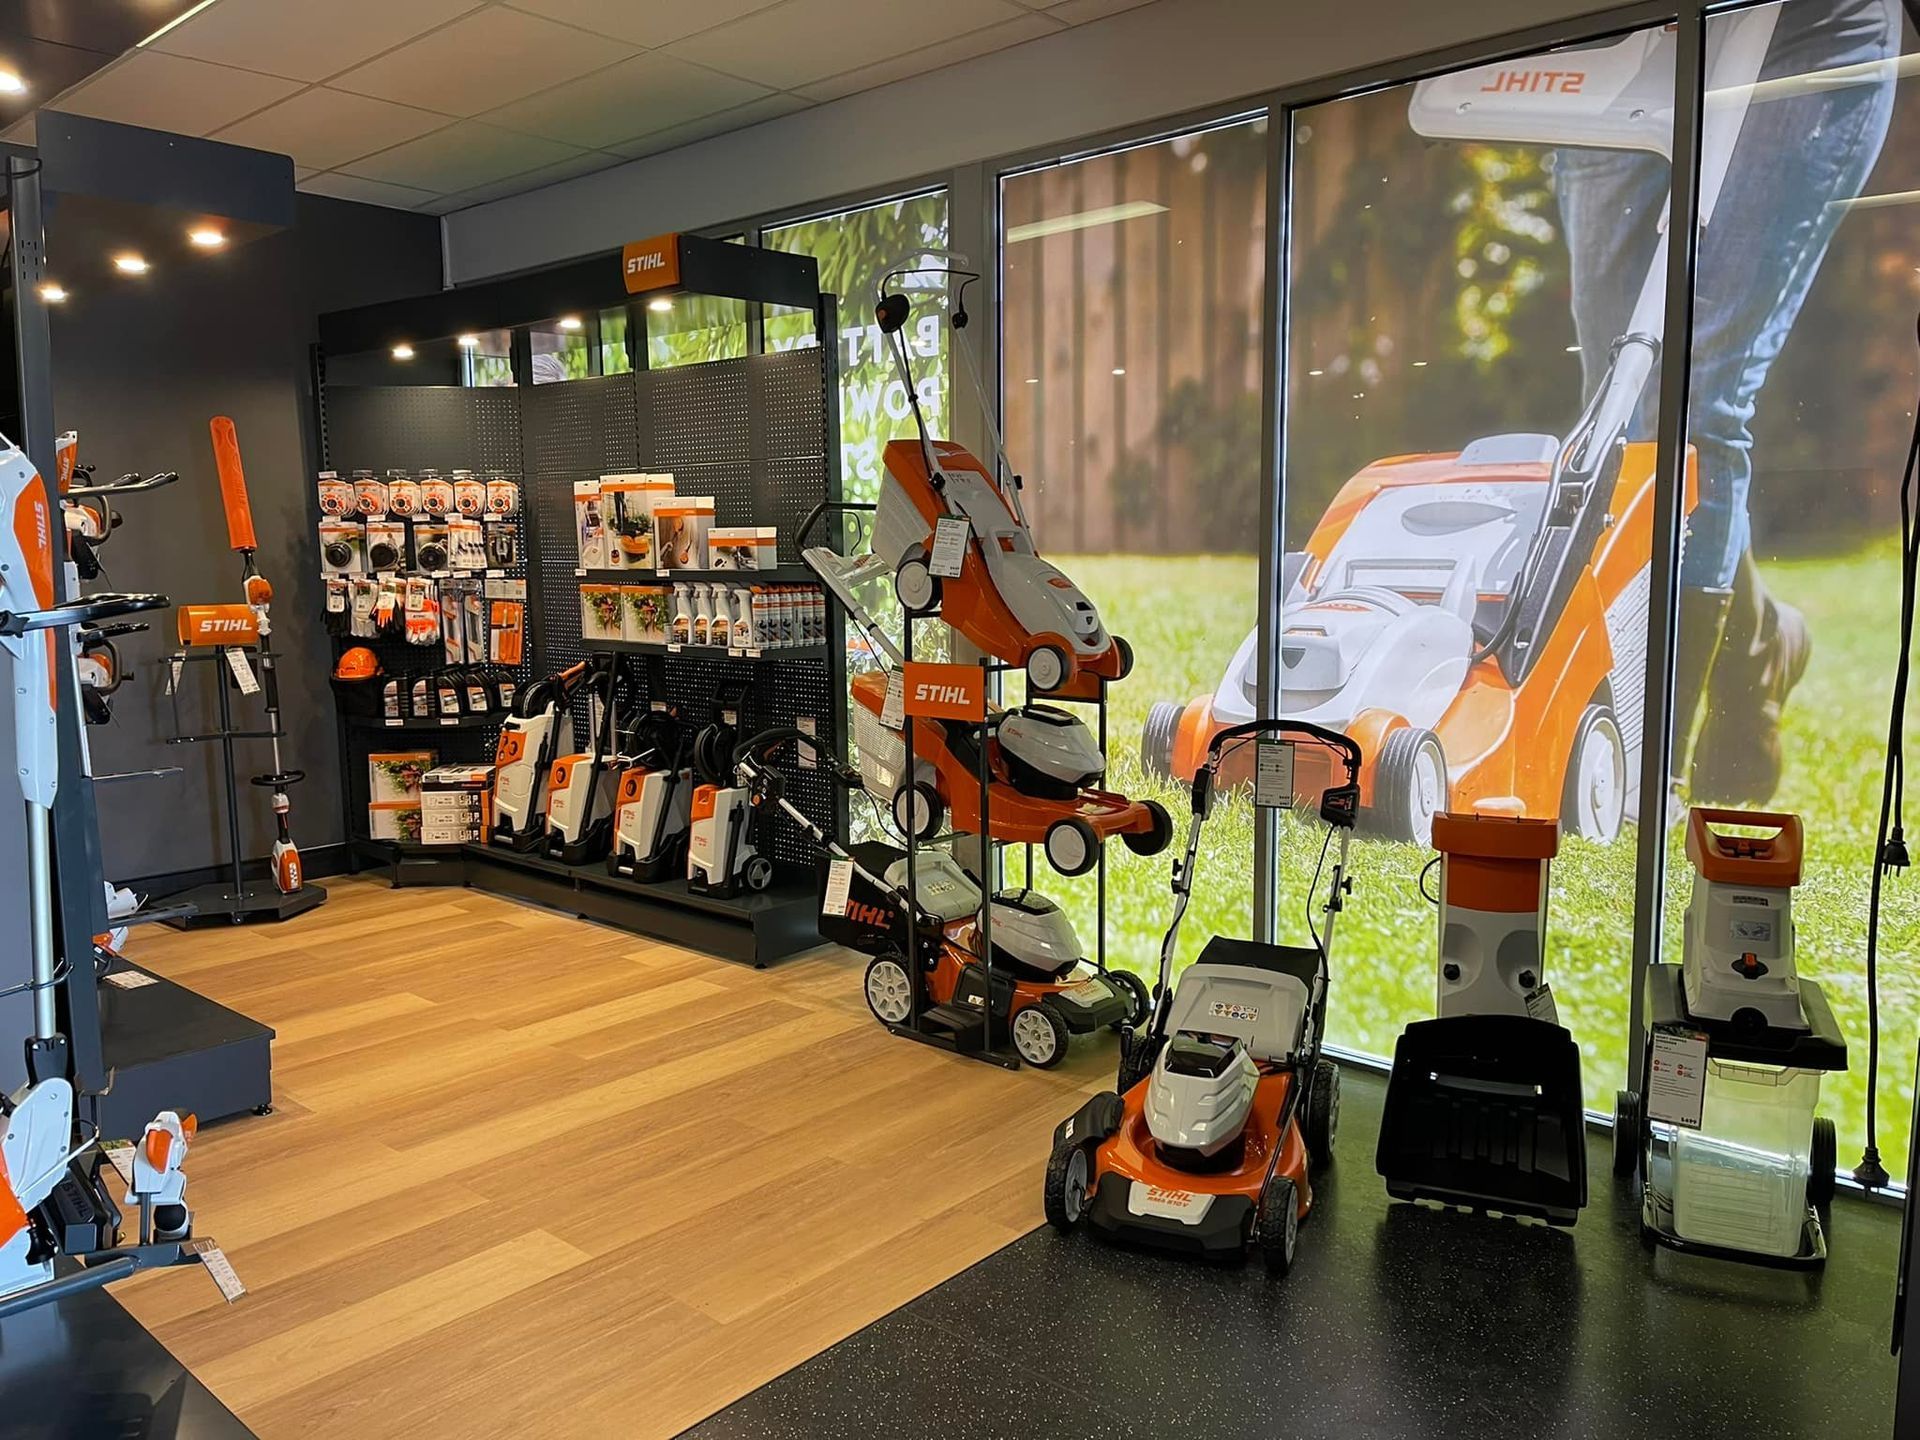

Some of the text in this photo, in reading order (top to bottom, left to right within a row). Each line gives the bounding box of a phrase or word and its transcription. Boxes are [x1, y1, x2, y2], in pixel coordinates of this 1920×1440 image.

[627, 252, 665, 274] STIHL
[61, 457, 69, 481] STIHL
[34, 501, 47, 550] STIHL
[200, 619, 252, 632] STIHL
[915, 684, 970, 705] STIHL
[62, 1182, 92, 1219] STIHL
[1147, 1187, 1192, 1202] STIHL
